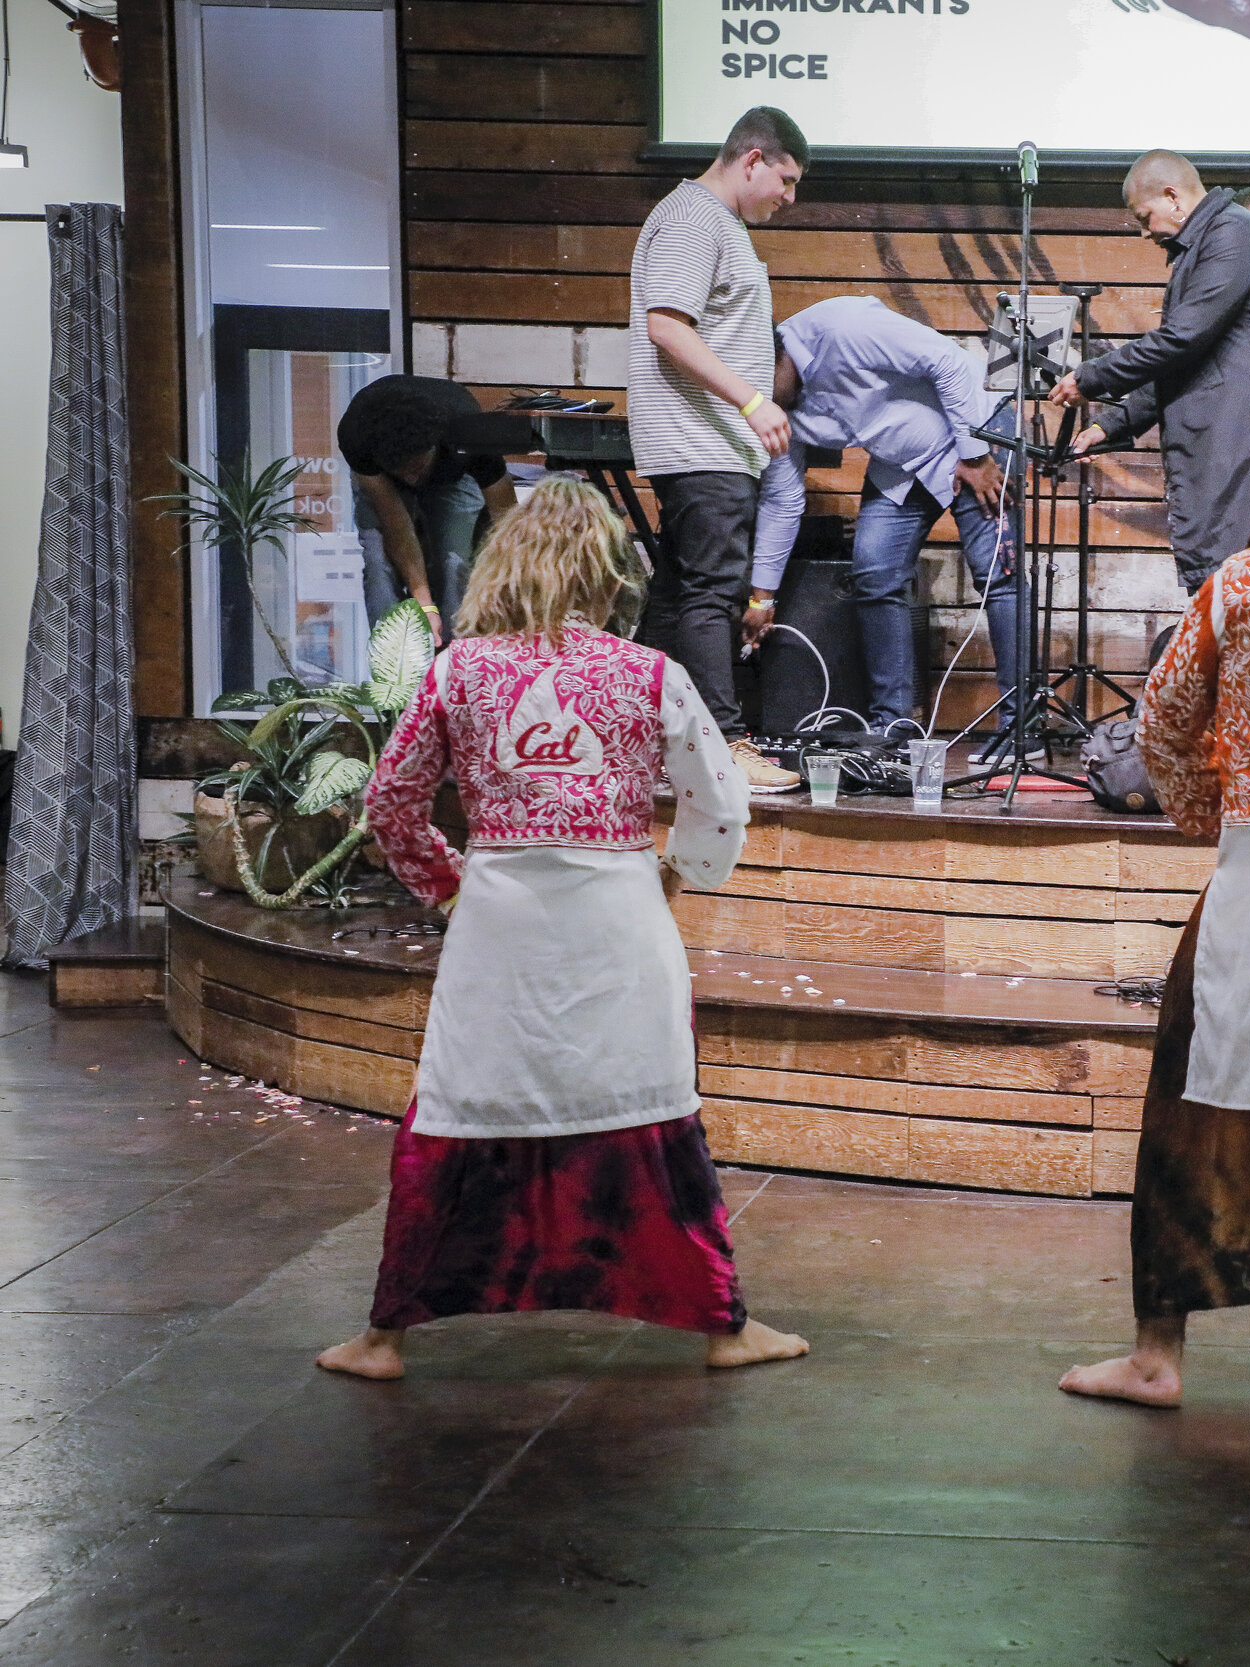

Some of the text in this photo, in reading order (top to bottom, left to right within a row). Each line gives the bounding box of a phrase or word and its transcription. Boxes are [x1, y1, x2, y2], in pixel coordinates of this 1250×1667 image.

[721, 19, 781, 45] NO
[721, 53, 829, 80] SPICE
[512, 721, 583, 770] Cal
